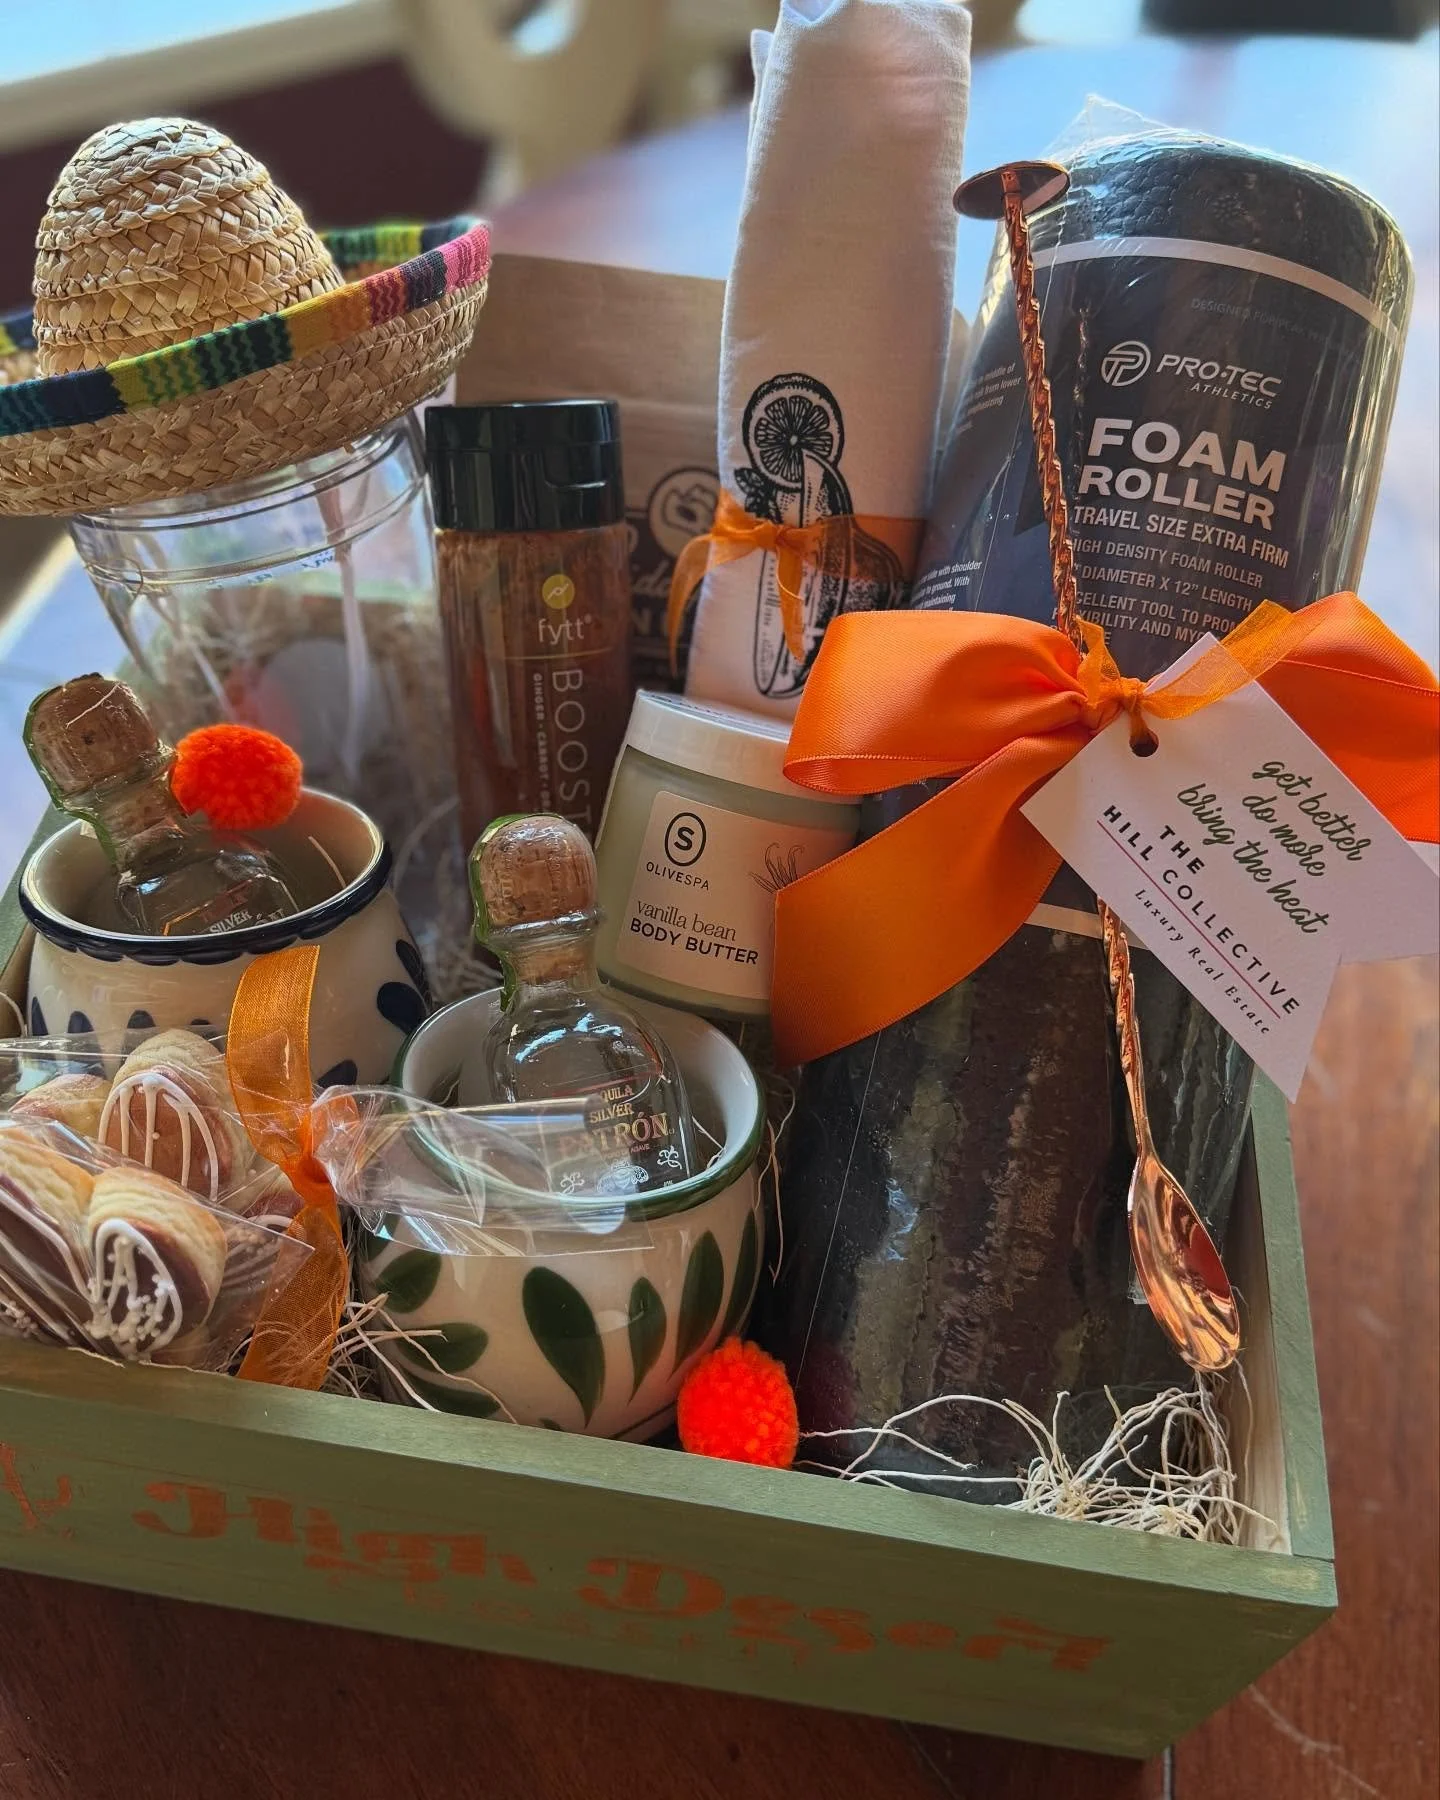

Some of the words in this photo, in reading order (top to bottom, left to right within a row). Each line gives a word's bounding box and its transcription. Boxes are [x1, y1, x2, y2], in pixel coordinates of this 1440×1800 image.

[1001, 377, 1021, 389] lower
[1191, 384, 1272, 409] ATHLETICS
[1088, 417, 1287, 492] FOAM
[1078, 465, 1274, 531] ROLLER
[1073, 506, 1141, 530] TRAVEL
[1146, 514, 1188, 538] SIZE
[1191, 523, 1246, 553] EXTRA
[1251, 540, 1289, 569] FIRM
[951, 561, 983, 574] shoulder
[954, 576, 970, 587] With
[1082, 565, 1155, 588] DIAMETER
[1159, 577, 1175, 591] X
[1201, 586, 1252, 612] LENGTH
[1106, 542, 1168, 564] DENSITY
[1171, 553, 1210, 572] FOAM
[1214, 562, 1263, 589] ROLLER
[1052, 607, 1137, 629] FXIBILITY
[1140, 620, 1177, 637] AND
[1075, 591, 1140, 612] CELLENT
[1142, 601, 1176, 620] TOOL
[1181, 609, 1199, 625] TO
[533, 673, 545, 721] GINGER
[537, 732, 550, 780] CARROT
[552, 669, 592, 827] BOOST
[1252, 761, 1313, 797] get
[1298, 792, 1372, 861] better
[1159, 825, 1206, 875] THE
[1177, 783, 1236, 846] bring
[1232, 840, 1272, 883] the
[1266, 879, 1330, 934] heat
[1242, 795, 1278, 823] do
[1269, 823, 1326, 877] more
[646, 861, 710, 891] OLIVESPA
[210, 911, 252, 933] SILVER
[637, 900, 687, 929] vanilla
[691, 913, 736, 941] bean
[1103, 805, 1153, 861] HILL
[1162, 869, 1300, 1014] COLLECTIVE
[630, 917, 682, 946] BODY
[685, 936, 759, 965] BUTTER
[1134, 888, 1184, 943] Luxury
[1188, 946, 1225, 981] Real
[1224, 984, 1270, 1034] Estate
[590, 1103, 634, 1124] SILVER
[600, 1084, 634, 1103] QUILA
